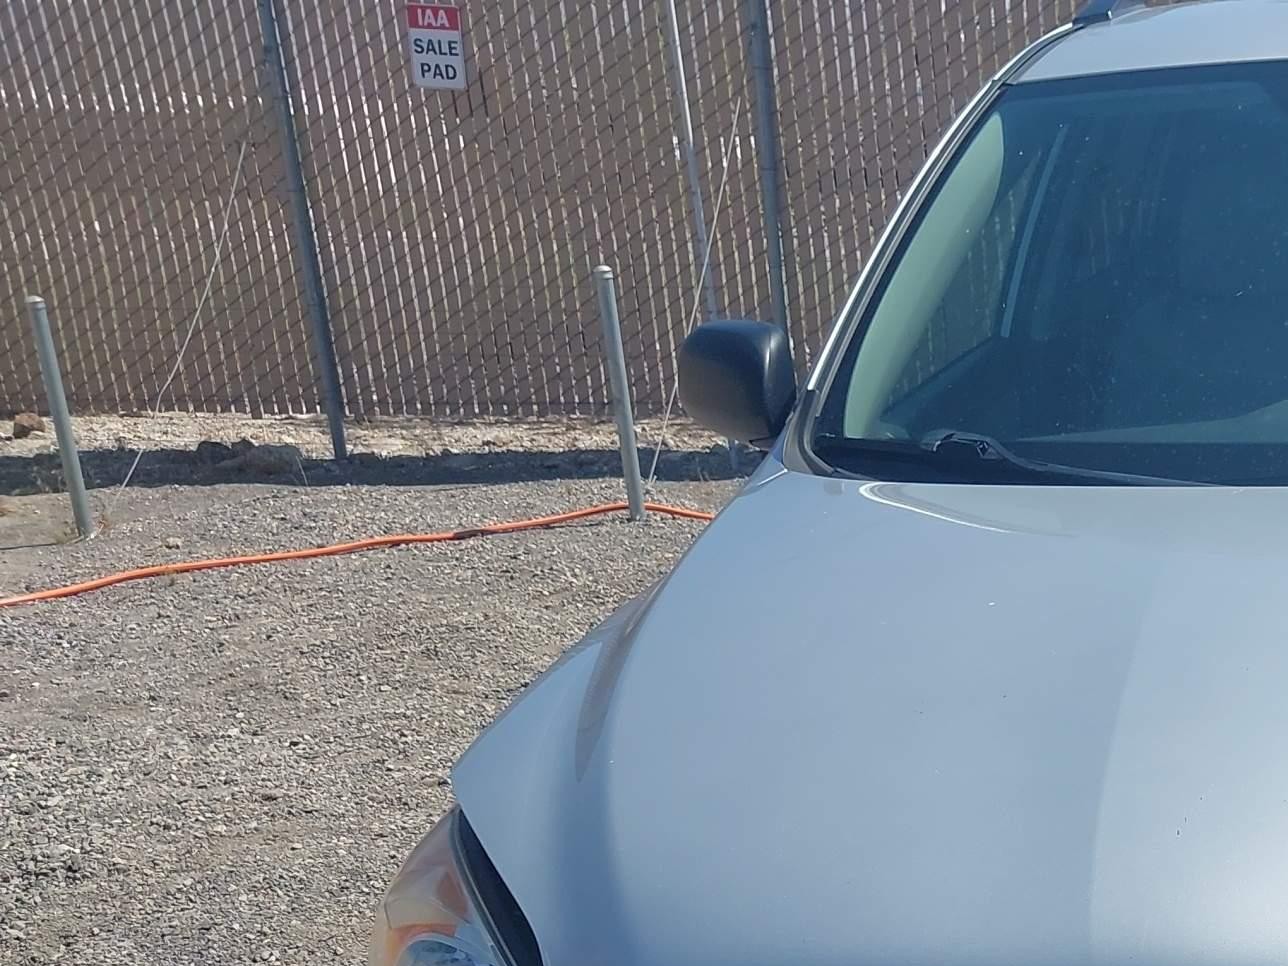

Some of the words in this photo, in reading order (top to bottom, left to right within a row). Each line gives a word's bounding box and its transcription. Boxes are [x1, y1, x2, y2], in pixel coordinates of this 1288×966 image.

[417, 8, 450, 27] IAA
[413, 38, 459, 56] SALE
[420, 62, 458, 80] PAD
